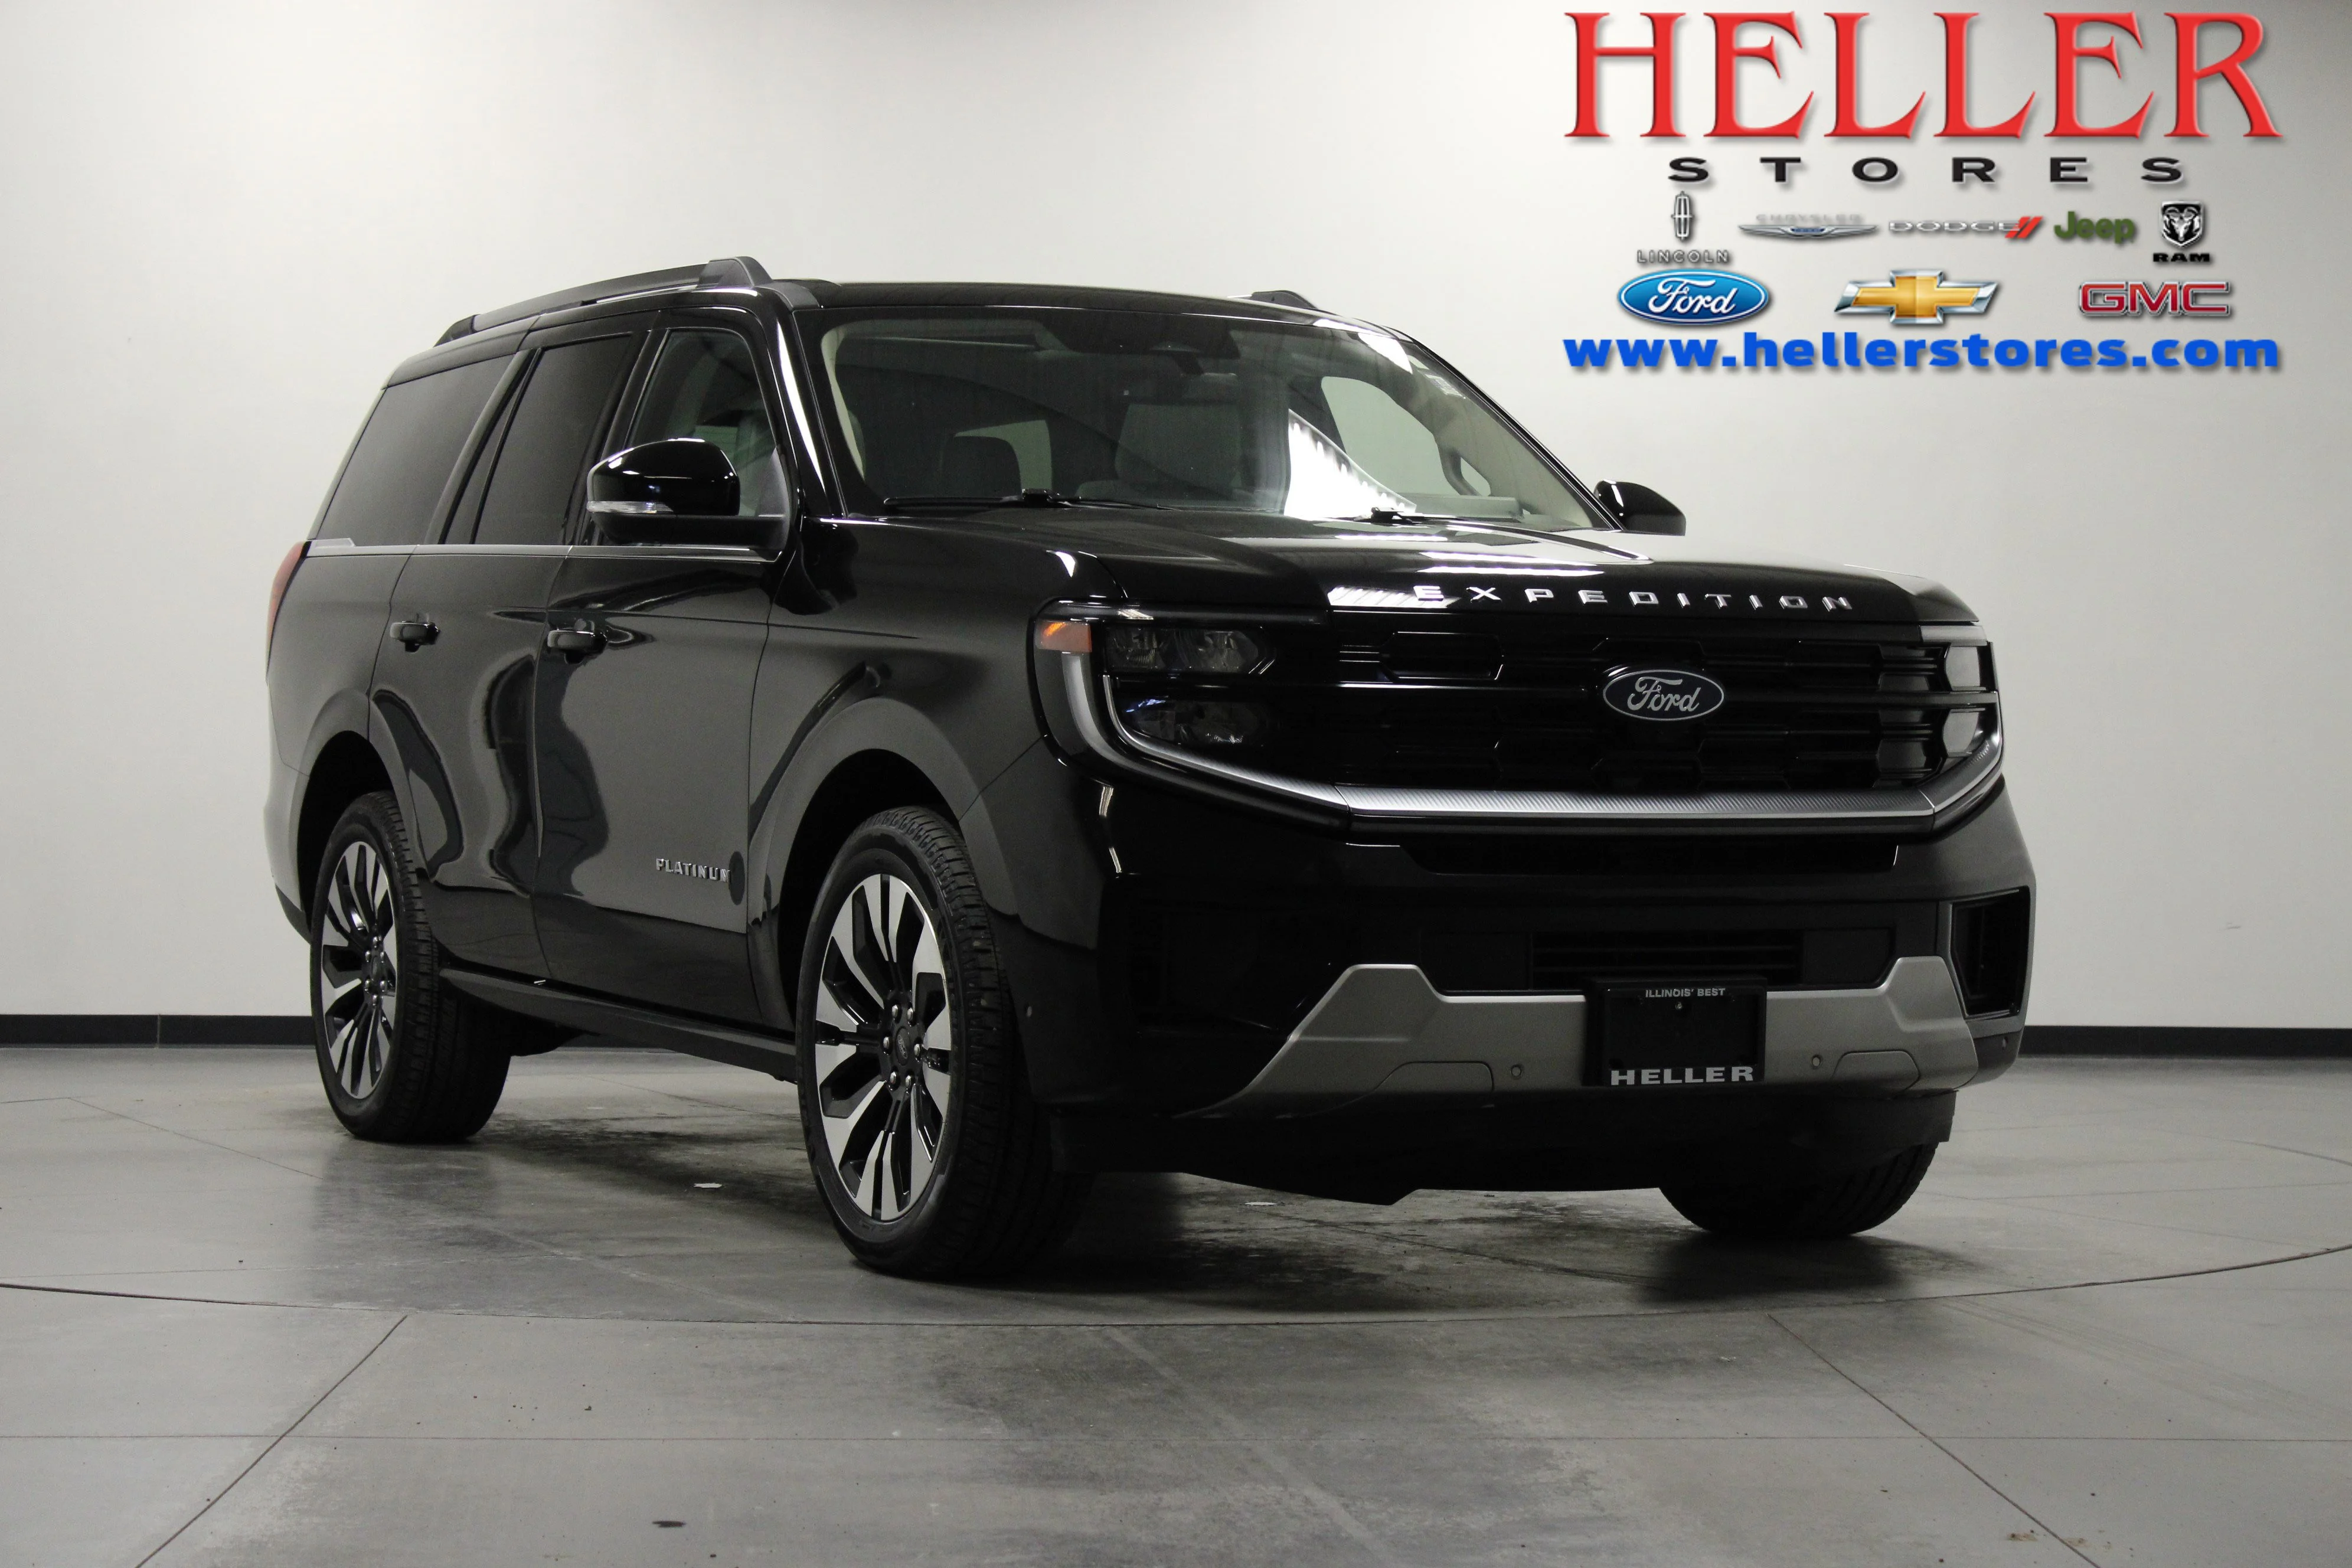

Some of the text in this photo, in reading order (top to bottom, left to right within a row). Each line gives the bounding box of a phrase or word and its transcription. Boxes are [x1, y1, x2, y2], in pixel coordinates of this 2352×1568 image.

[1413, 585, 1853, 612] EXPEDITION
[1627, 676, 1701, 712] Ford
[656, 858, 731, 883] PLATINUM
[1697, 988, 1726, 997] BEST
[1611, 1066, 1754, 1086] HELLER
